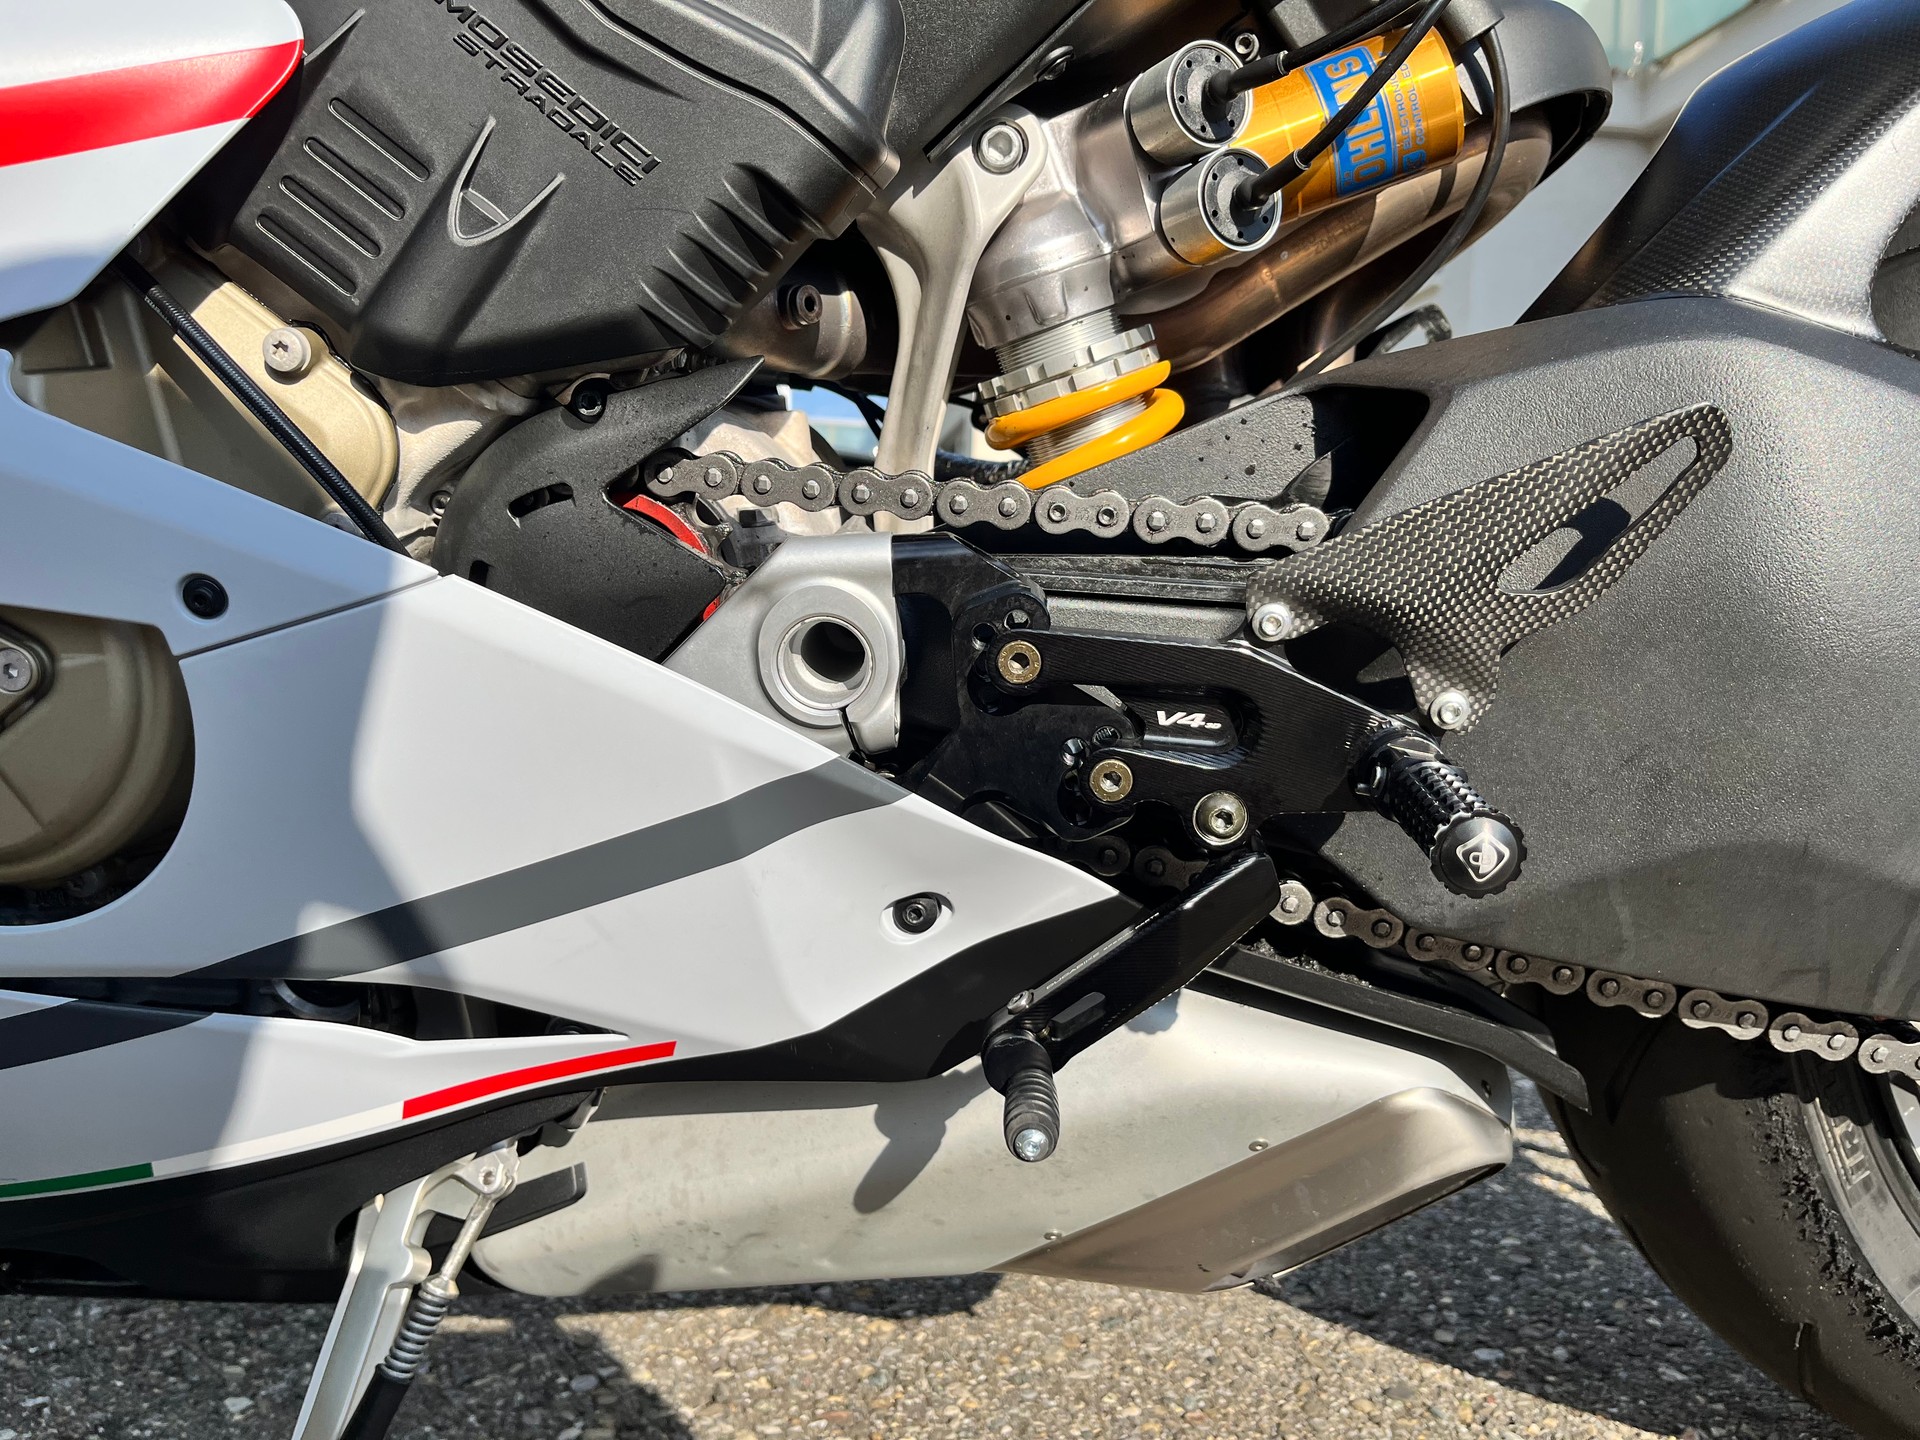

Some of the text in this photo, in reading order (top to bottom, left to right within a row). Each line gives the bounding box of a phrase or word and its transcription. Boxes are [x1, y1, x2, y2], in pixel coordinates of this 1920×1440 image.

[452, 31, 644, 187] STRADALE
[1325, 56, 1387, 187] ÖHLNS
[1400, 63, 1426, 146] CONTROLED
[1156, 710, 1206, 728] V4
